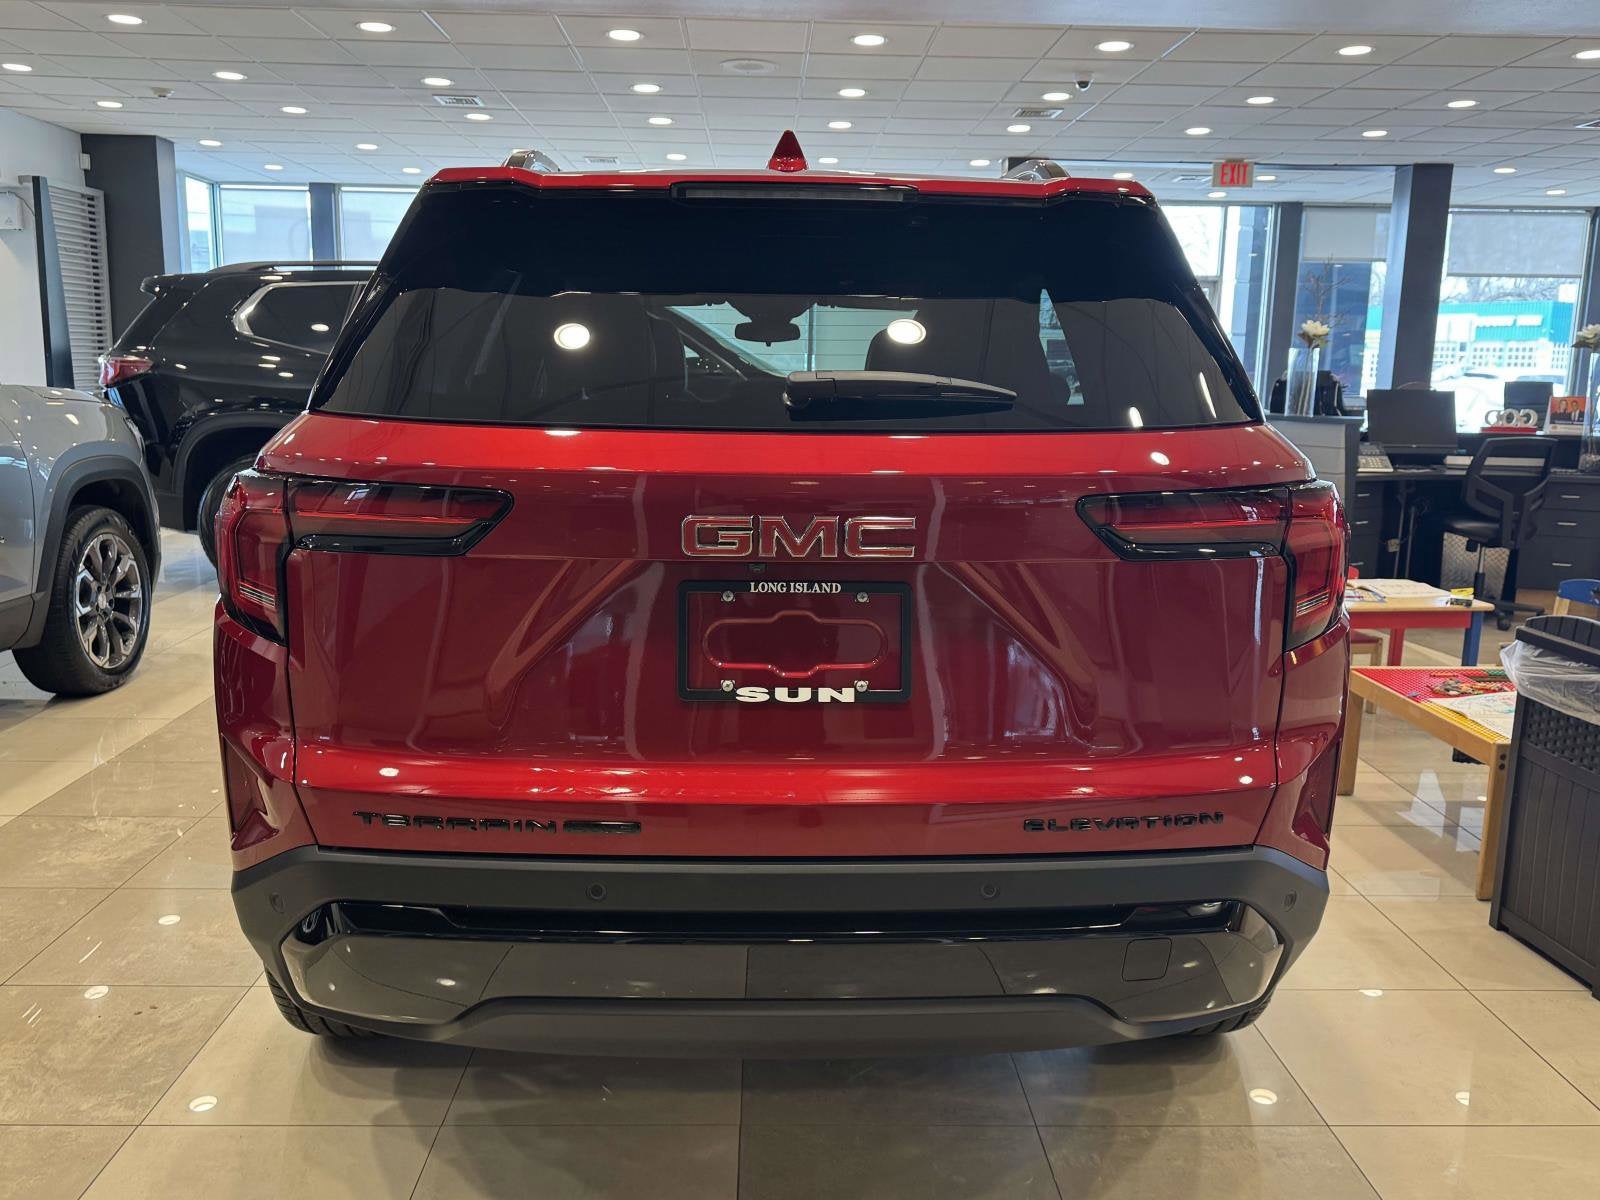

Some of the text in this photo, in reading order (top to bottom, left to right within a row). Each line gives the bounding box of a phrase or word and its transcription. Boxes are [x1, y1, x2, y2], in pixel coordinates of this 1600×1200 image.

[1221, 163, 1248, 185] EXIT
[681, 515, 917, 557] GMC
[750, 582, 842, 594] LONG ISLAND
[735, 686, 856, 703] SUN
[353, 811, 556, 833] TERRAIN
[1023, 811, 1224, 832] ELEVATION
